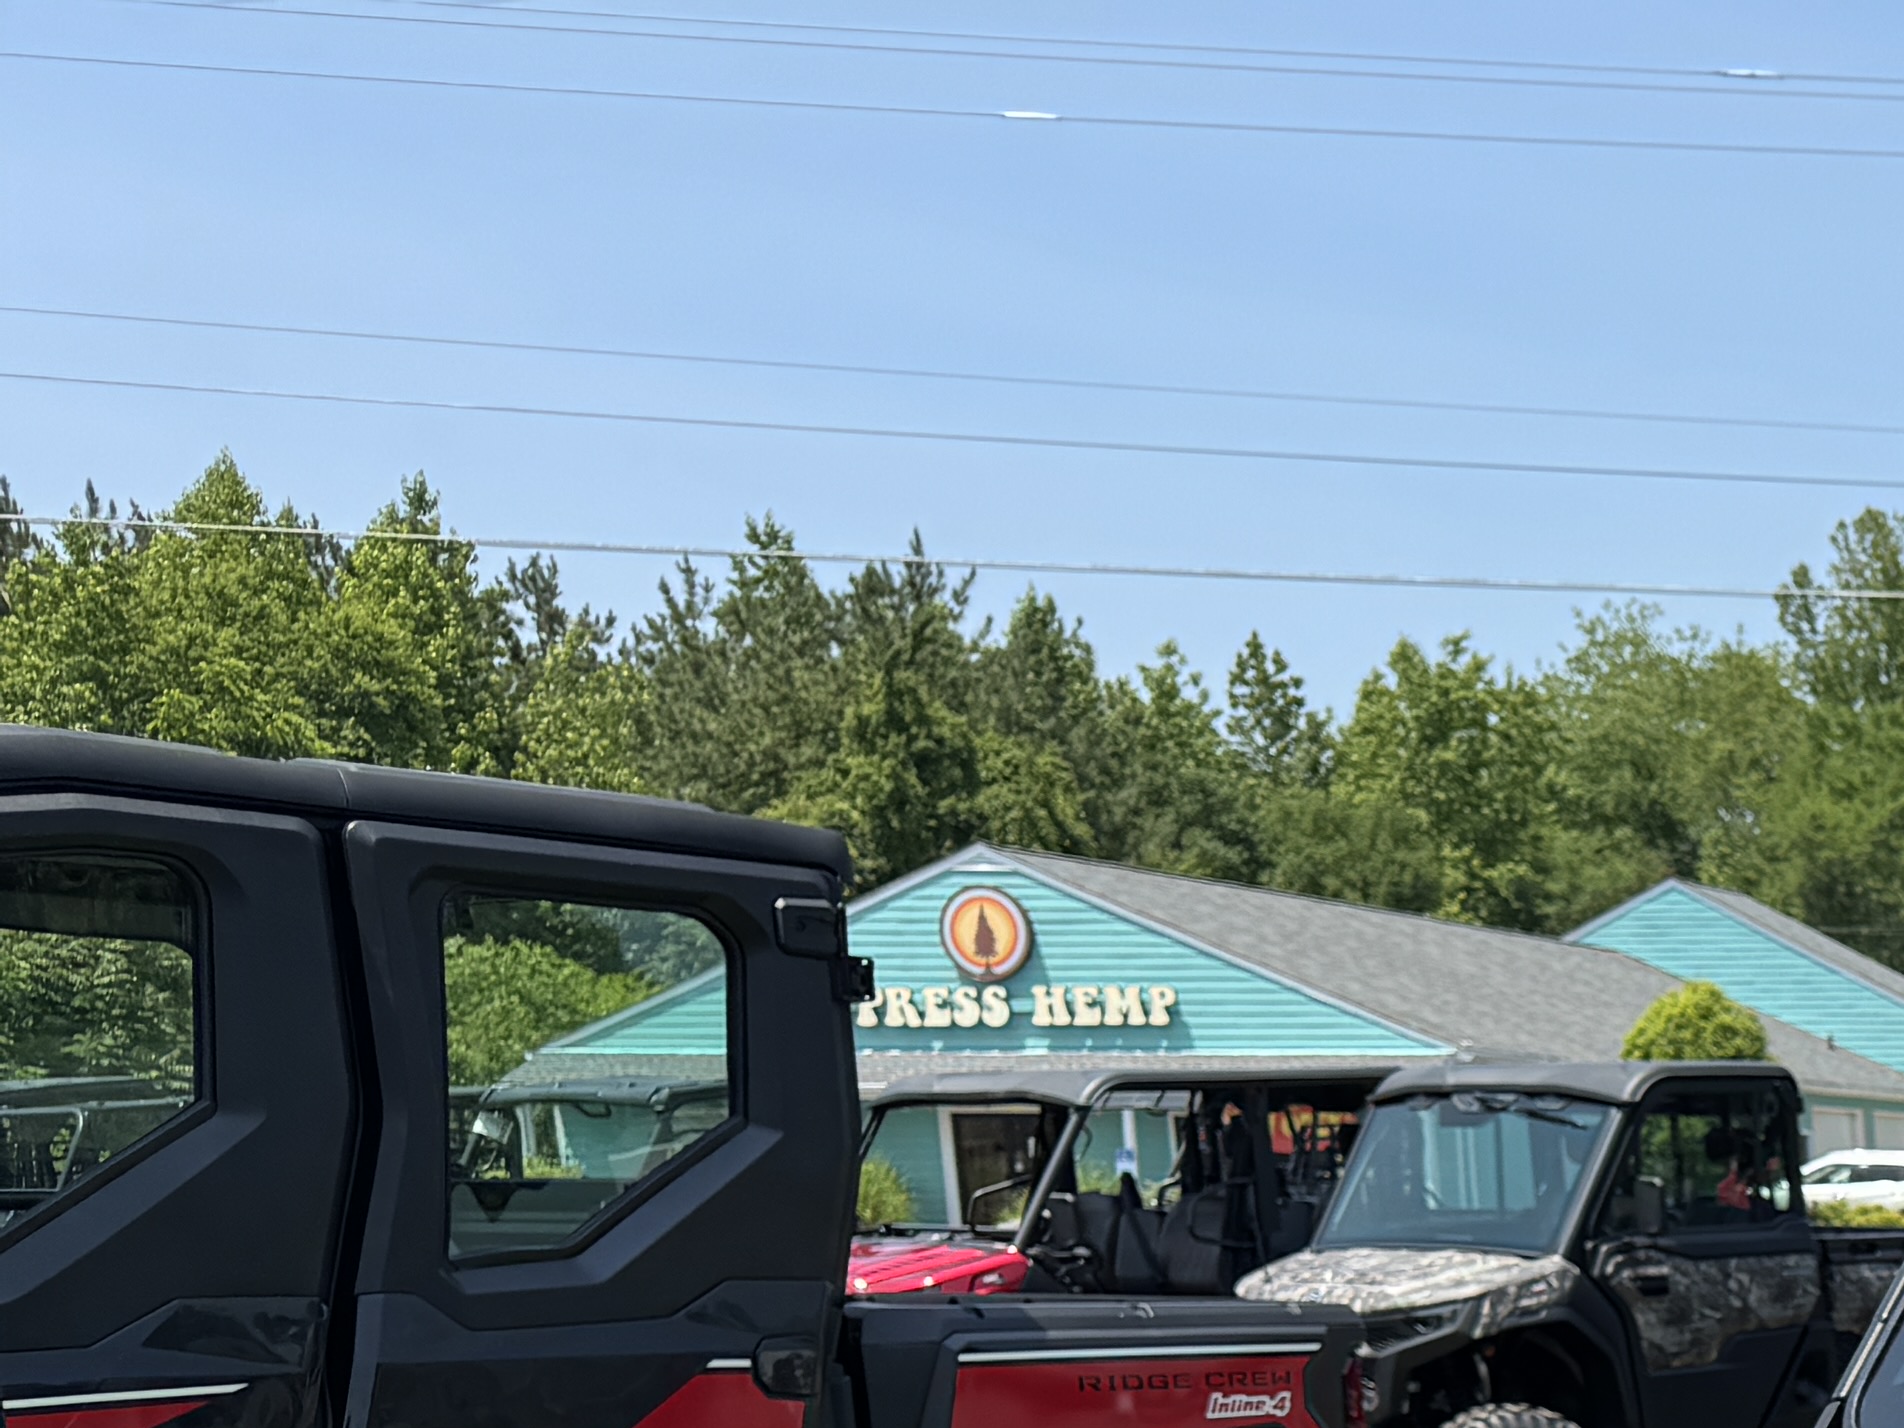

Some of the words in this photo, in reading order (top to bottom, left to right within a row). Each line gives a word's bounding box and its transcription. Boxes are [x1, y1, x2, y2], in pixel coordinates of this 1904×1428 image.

[1031, 984, 1177, 1027] HEMP
[1078, 1373, 1192, 1392] RIDGE
[1205, 1371, 1291, 1388] CREW
[1211, 1396, 1266, 1414] Inline
[1273, 1396, 1287, 1412] 4
